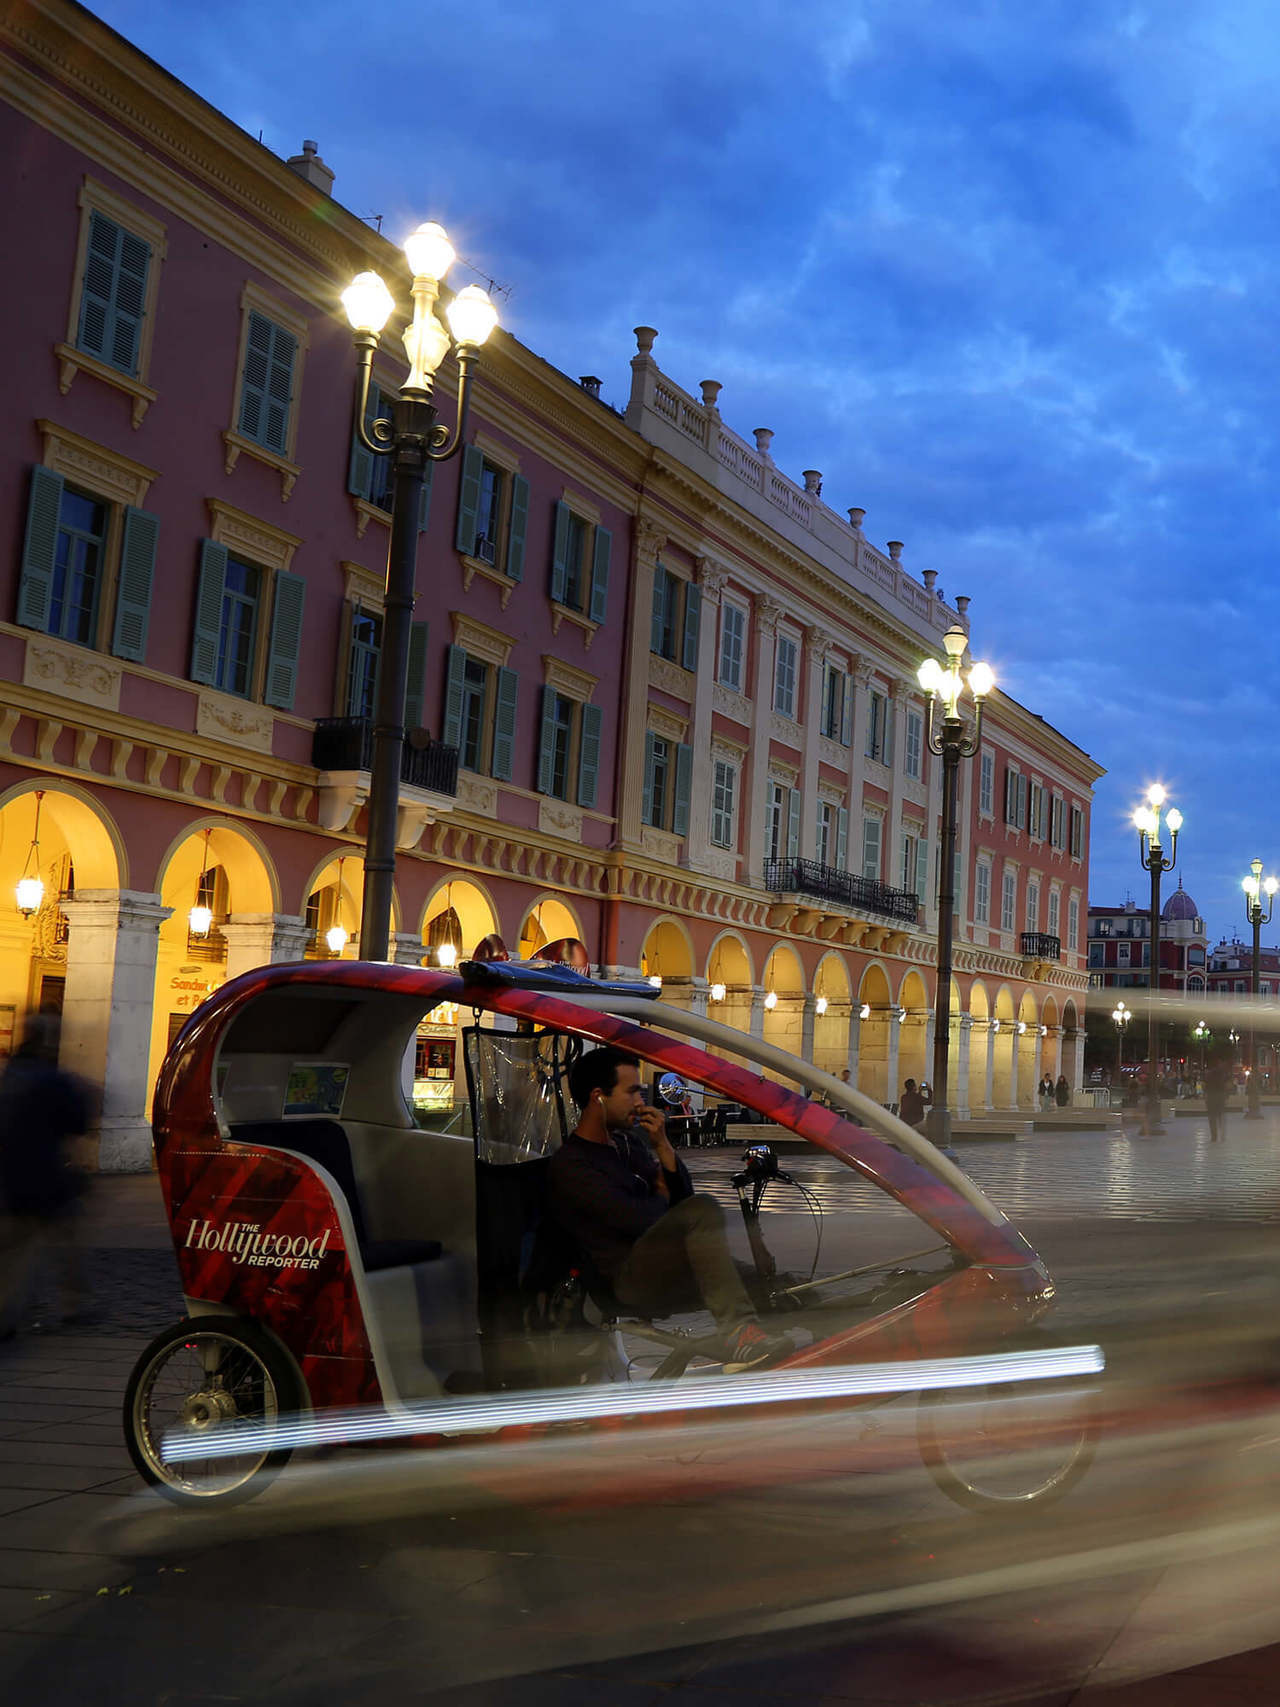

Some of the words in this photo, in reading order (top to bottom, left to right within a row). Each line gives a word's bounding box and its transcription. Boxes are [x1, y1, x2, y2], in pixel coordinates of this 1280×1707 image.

[242, 1224, 260, 1232] THE
[185, 1219, 331, 1264] Hollywood
[248, 1255, 319, 1270] REPORTER
